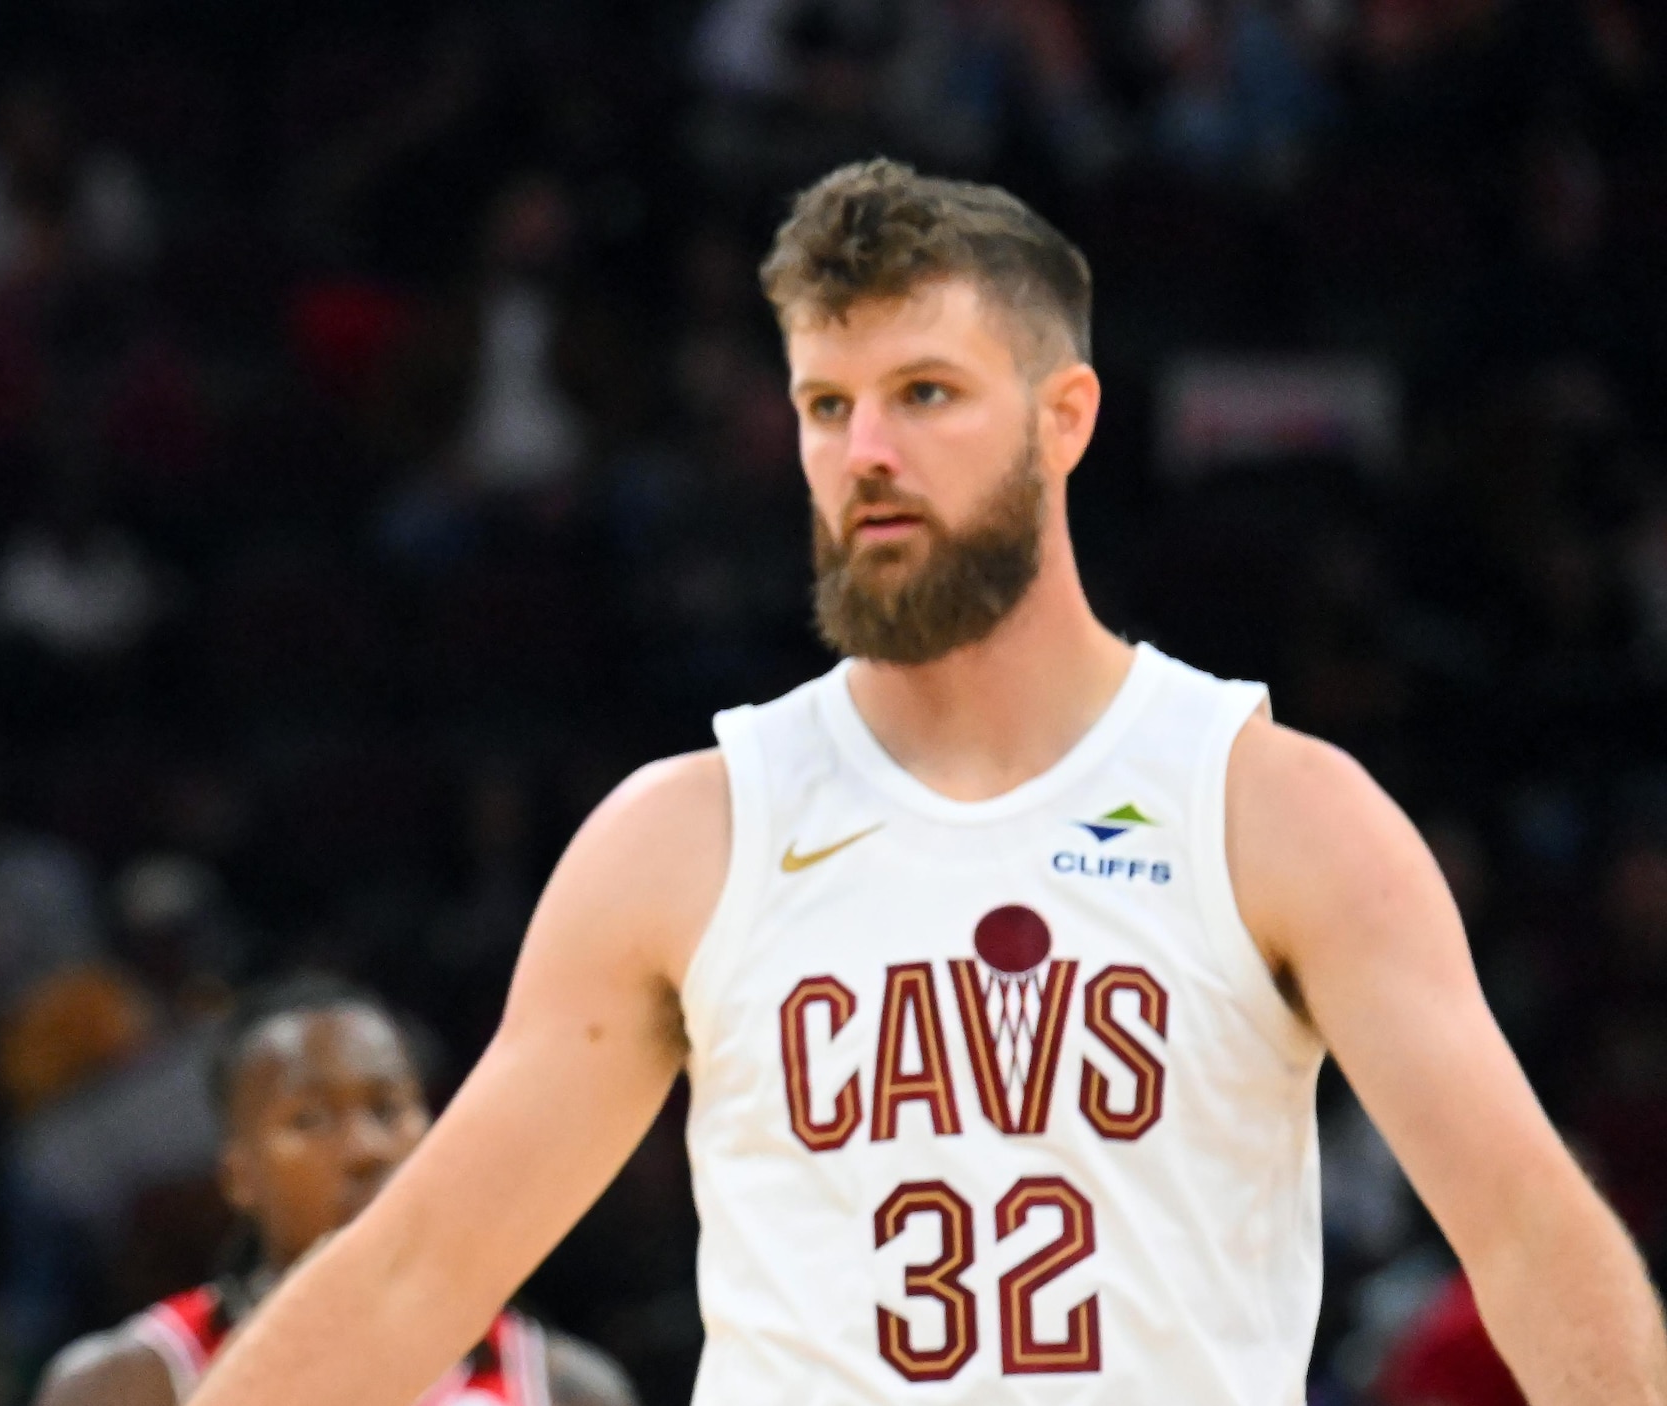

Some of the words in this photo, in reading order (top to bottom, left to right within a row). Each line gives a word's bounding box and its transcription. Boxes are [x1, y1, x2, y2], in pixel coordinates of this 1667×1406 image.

[1052, 850, 1171, 885] CLIFFS
[779, 959, 1170, 1152] CAVS
[873, 1176, 1103, 1382] 32
